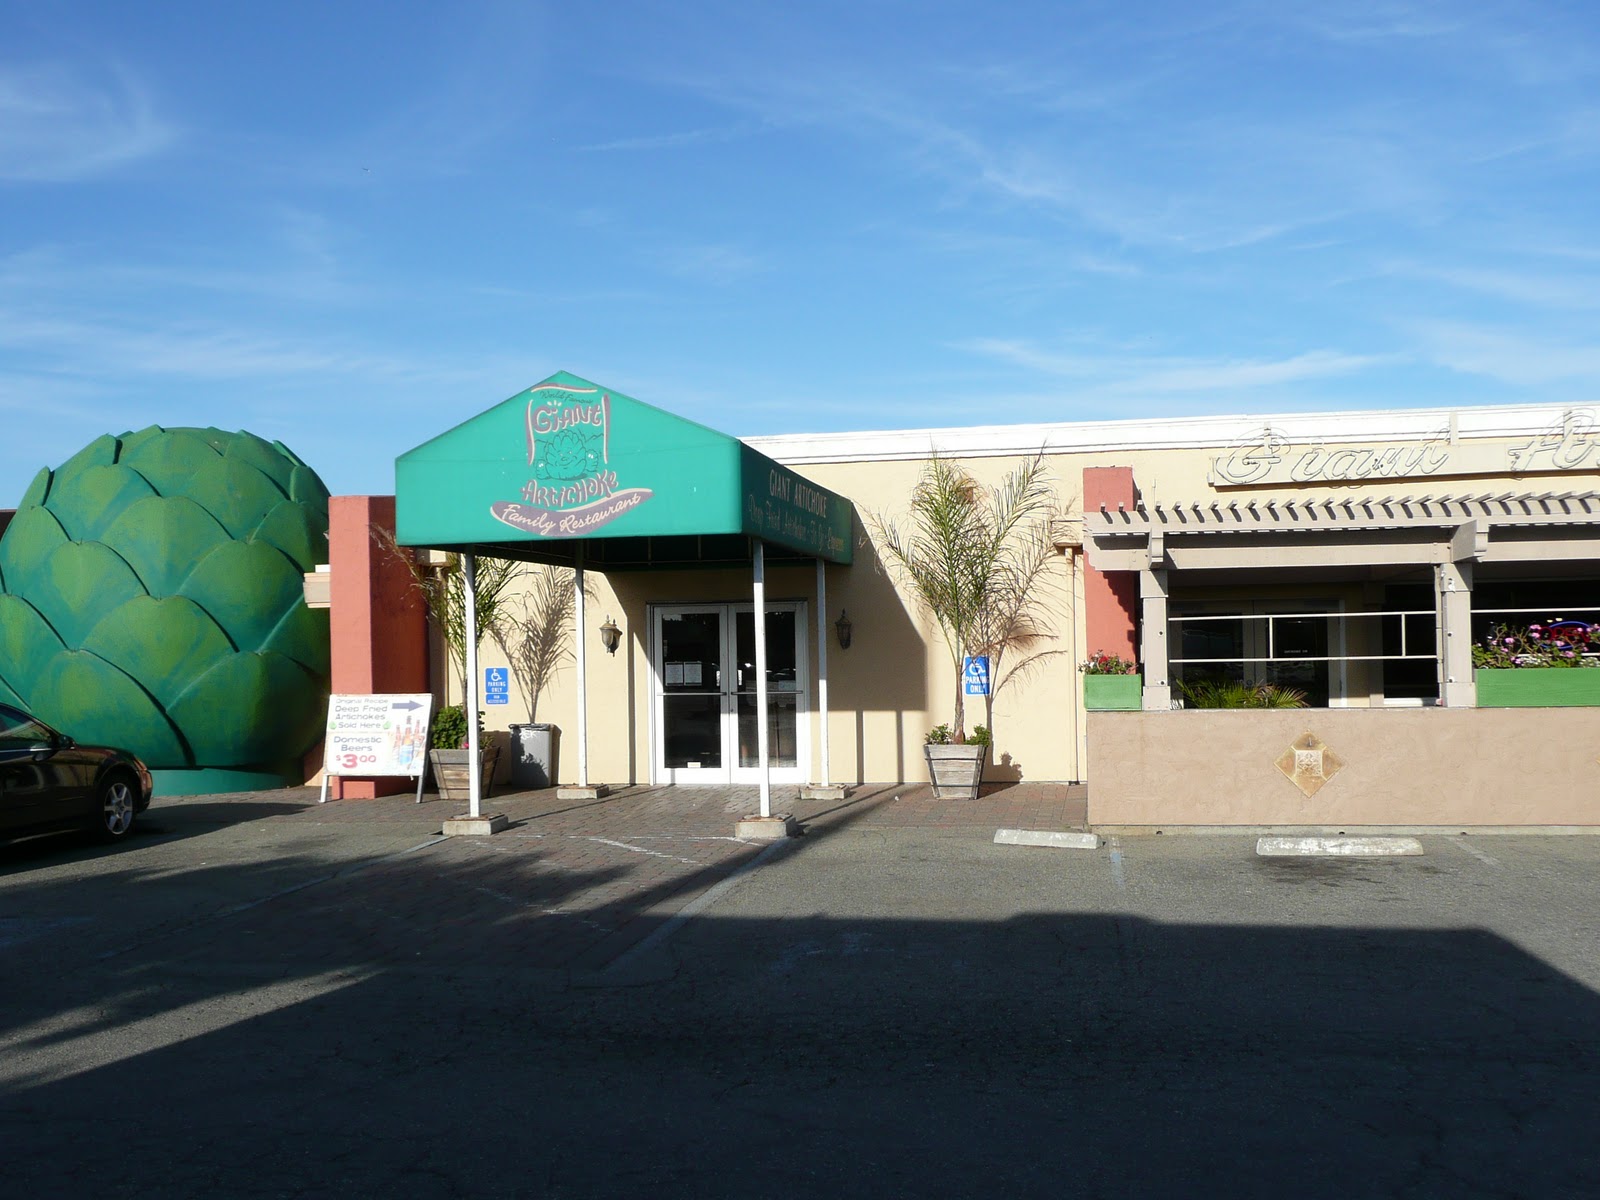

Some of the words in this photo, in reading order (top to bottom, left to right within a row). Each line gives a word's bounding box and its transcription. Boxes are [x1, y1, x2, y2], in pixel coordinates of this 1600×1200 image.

[769, 469, 790, 502] GIANT
[794, 483, 827, 518] ARTICHOKE
[502, 504, 556, 536] Family
[559, 492, 642, 534] Restaurant
[334, 705, 360, 713] Deep
[362, 704, 388, 712] Fried
[338, 721, 357, 729] Sold
[359, 721, 381, 729] Here
[333, 735, 382, 744] Domestic
[340, 744, 373, 752] Beers
